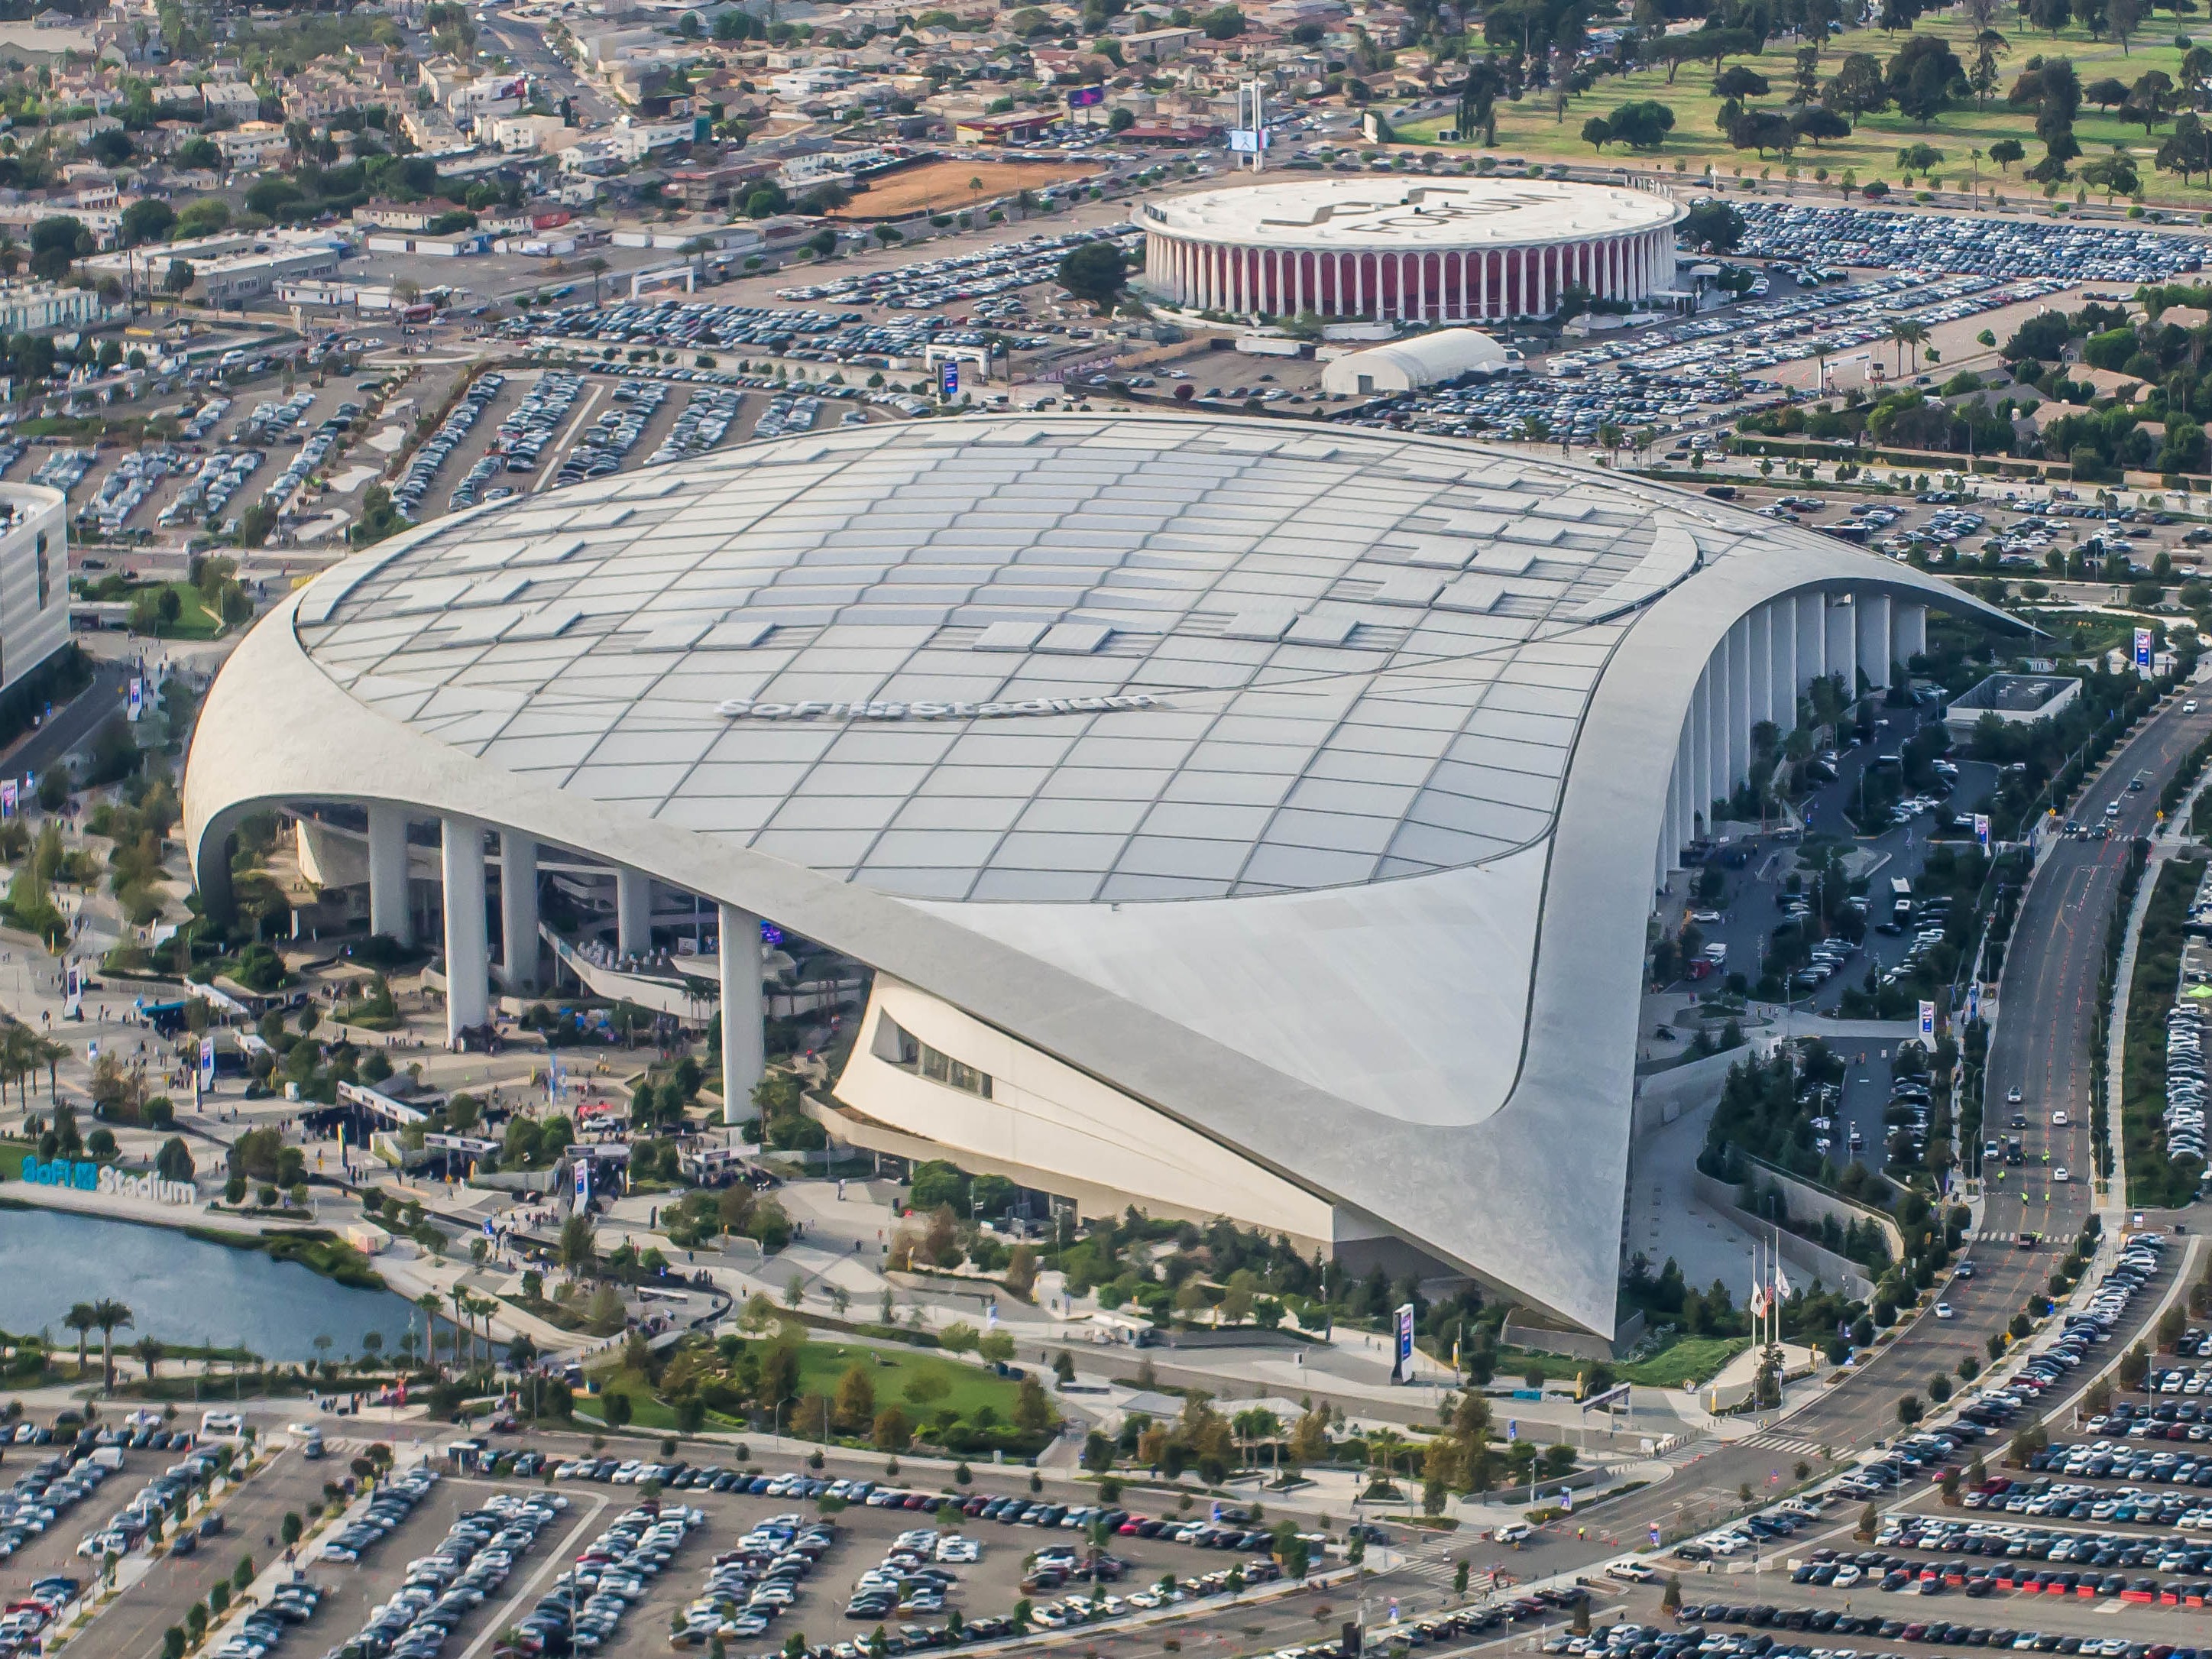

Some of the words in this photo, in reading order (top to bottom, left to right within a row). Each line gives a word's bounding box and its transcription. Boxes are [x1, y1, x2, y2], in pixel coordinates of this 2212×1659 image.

[1342, 193, 1572, 234] FORUM
[909, 695, 1160, 716] Stadium
[99, 1165, 196, 1205] Stadium
